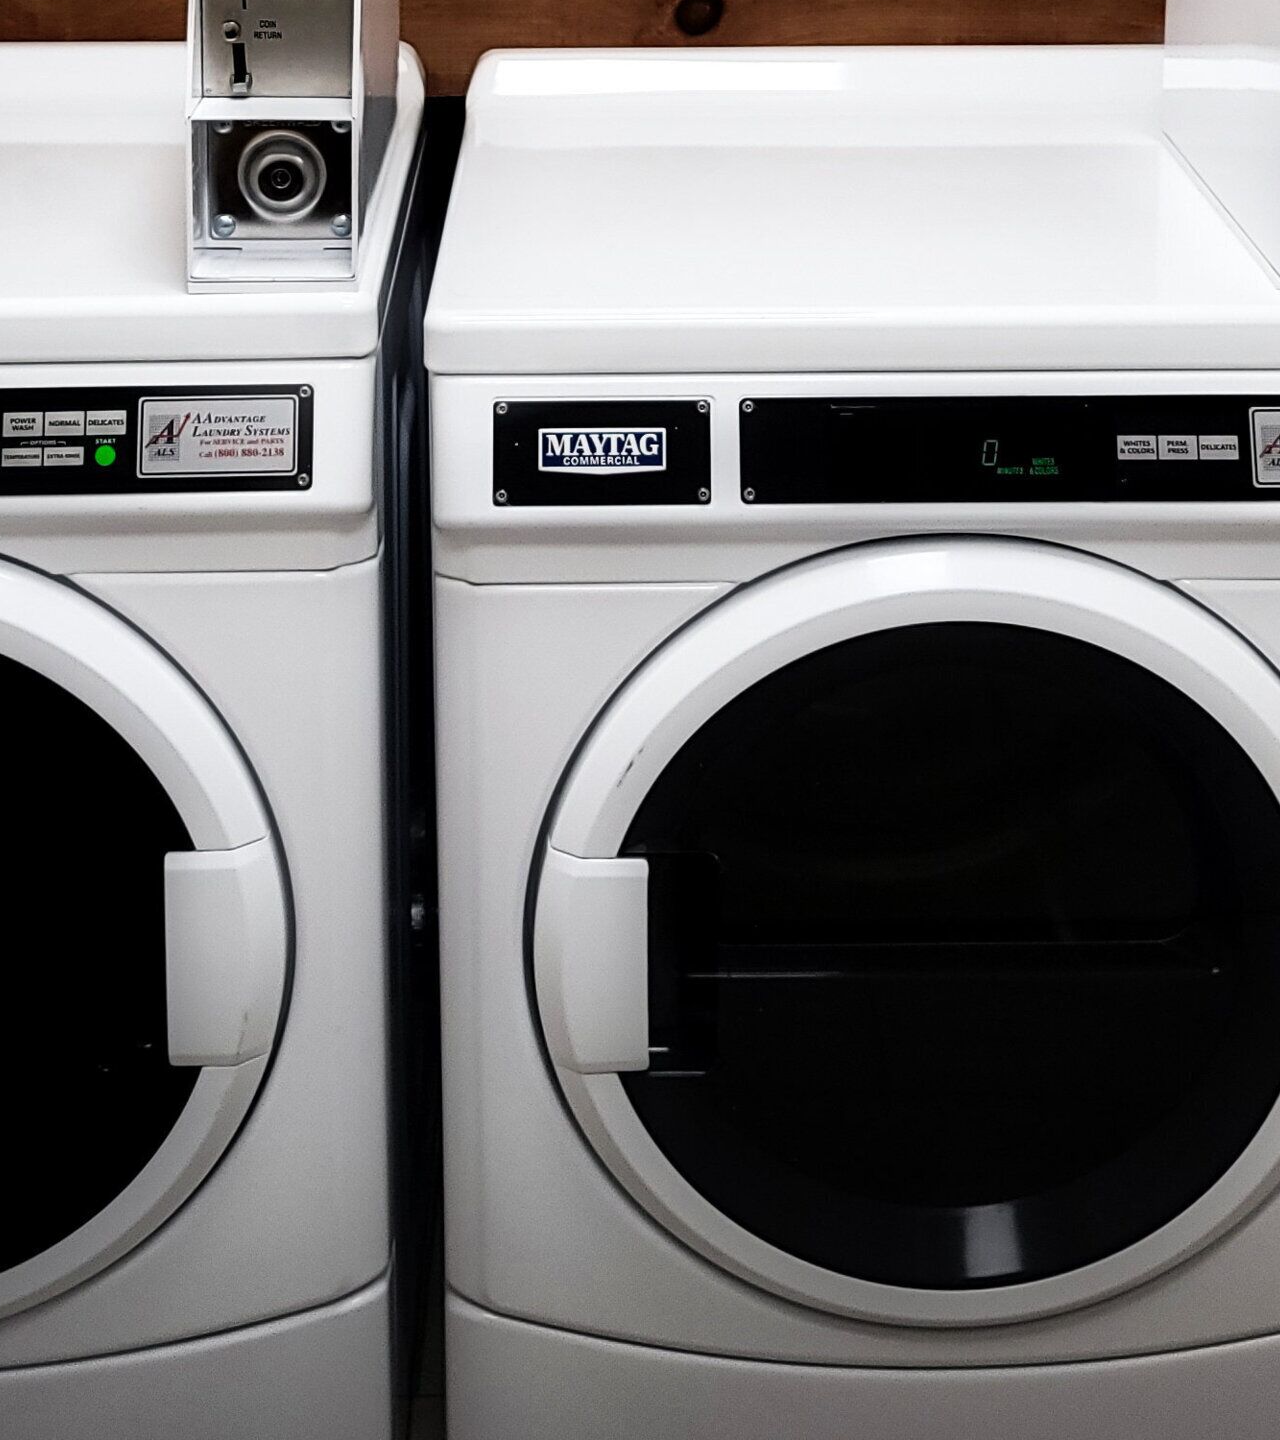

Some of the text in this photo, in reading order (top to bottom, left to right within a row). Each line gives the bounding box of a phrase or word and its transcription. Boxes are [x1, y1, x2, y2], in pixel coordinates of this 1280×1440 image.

[259, 20, 277, 28] COIN
[253, 30, 282, 39] RETURN
[10, 417, 37, 425] POWER
[87, 418, 125, 426] DELICATES
[11, 424, 34, 432] WASH
[192, 424, 291, 437] LAUNDRY SYSTEMS
[545, 433, 660, 457] MAYTAG
[154, 448, 175, 457] ALS
[241, 447, 285, 457] 880-2138
[562, 456, 640, 466] COMMERCIAL
